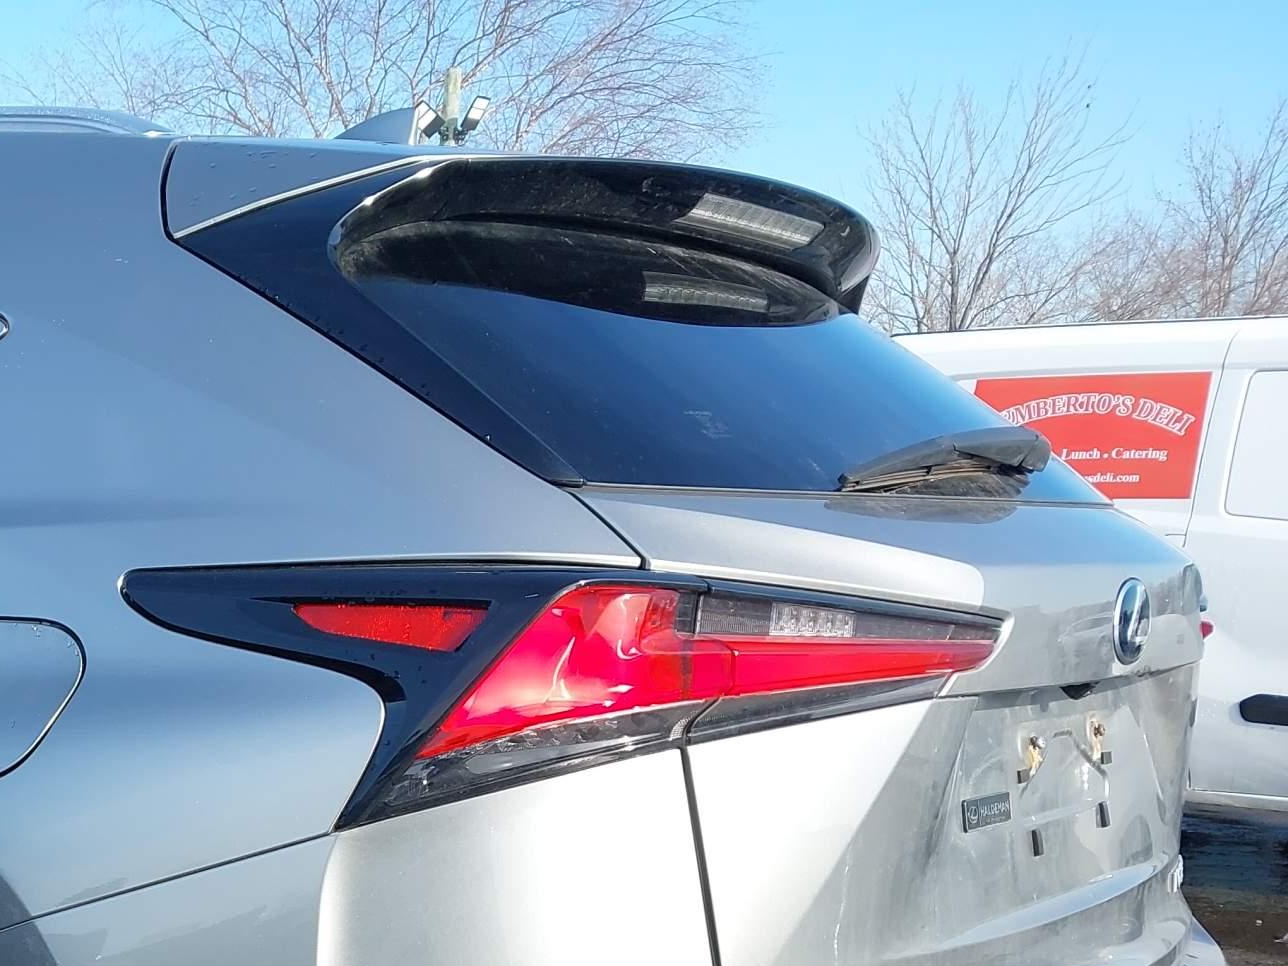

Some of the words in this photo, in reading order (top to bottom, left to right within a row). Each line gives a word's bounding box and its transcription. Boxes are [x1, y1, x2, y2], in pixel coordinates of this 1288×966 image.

[1133, 398, 1196, 436] DELI
[1061, 448, 1101, 460] Lunch
[1111, 447, 1169, 461] Catering
